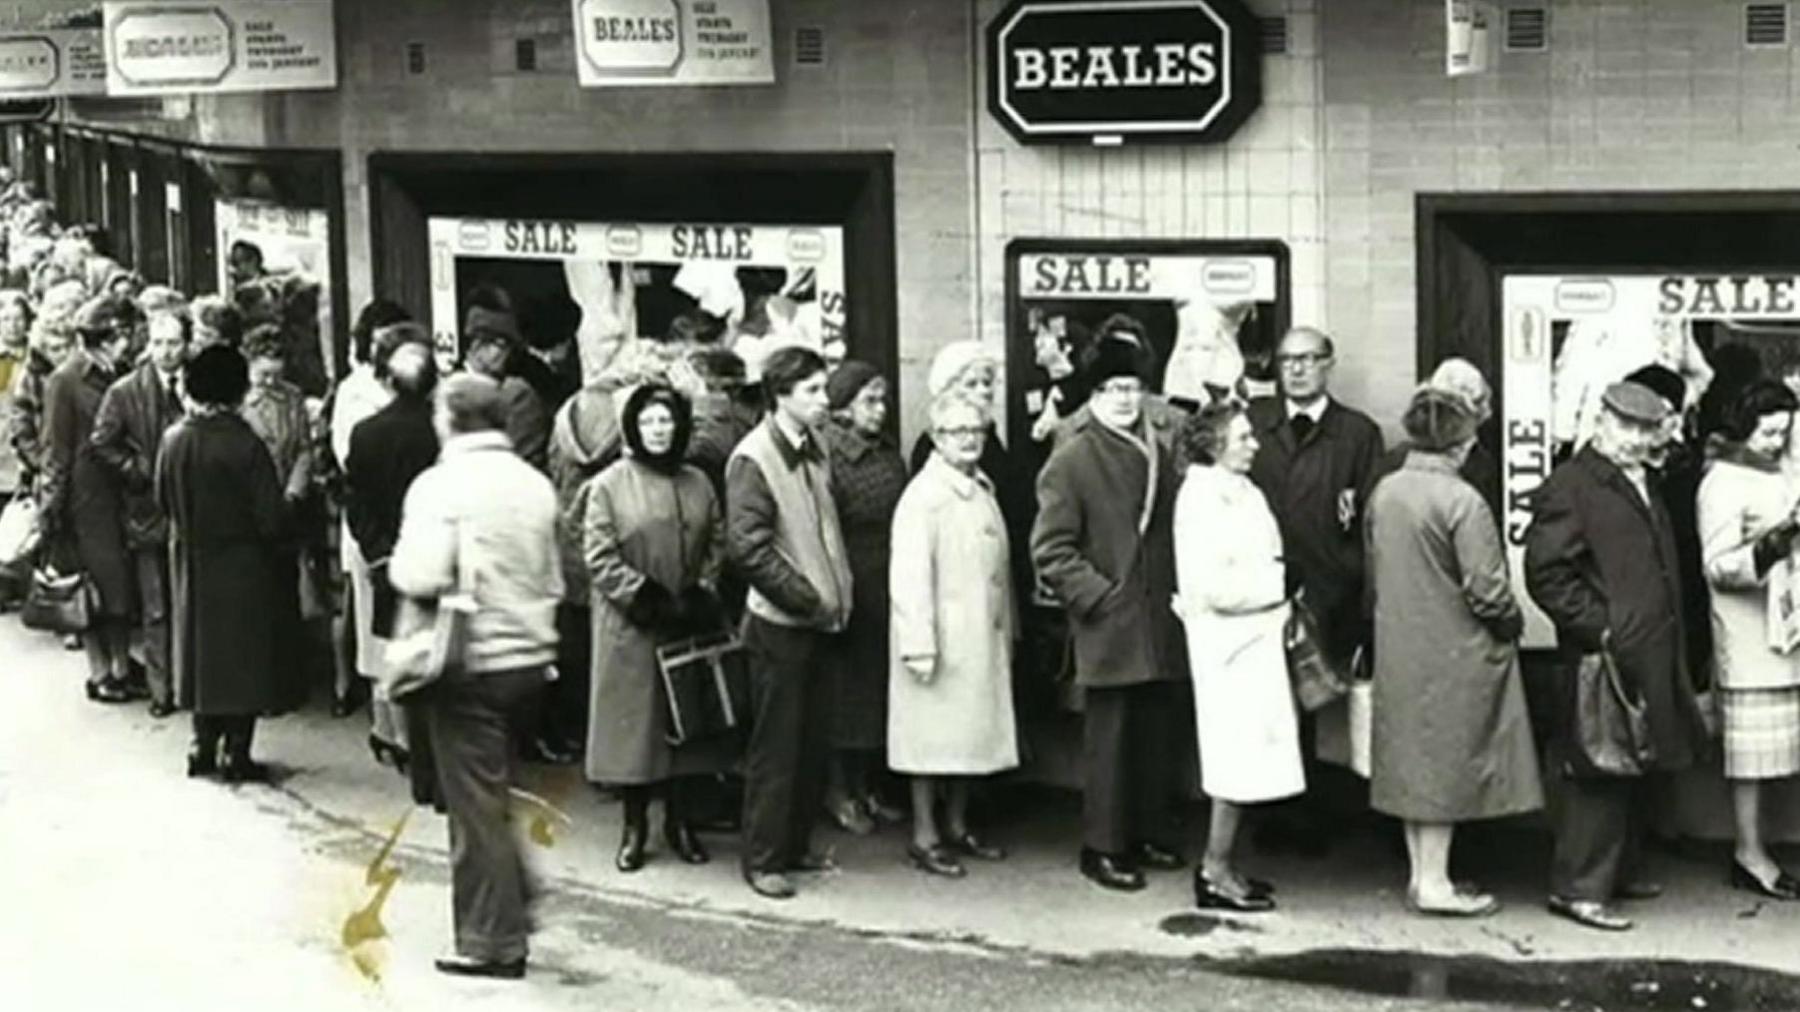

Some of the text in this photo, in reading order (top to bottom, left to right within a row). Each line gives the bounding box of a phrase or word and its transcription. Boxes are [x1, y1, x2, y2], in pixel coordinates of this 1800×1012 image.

[593, 17, 675, 41] BEALES
[1014, 43, 1216, 88] BEALES
[505, 219, 577, 255] SALE
[672, 224, 752, 260] SALE
[1035, 257, 1150, 293] SALE
[1658, 277, 1795, 314] SALE
